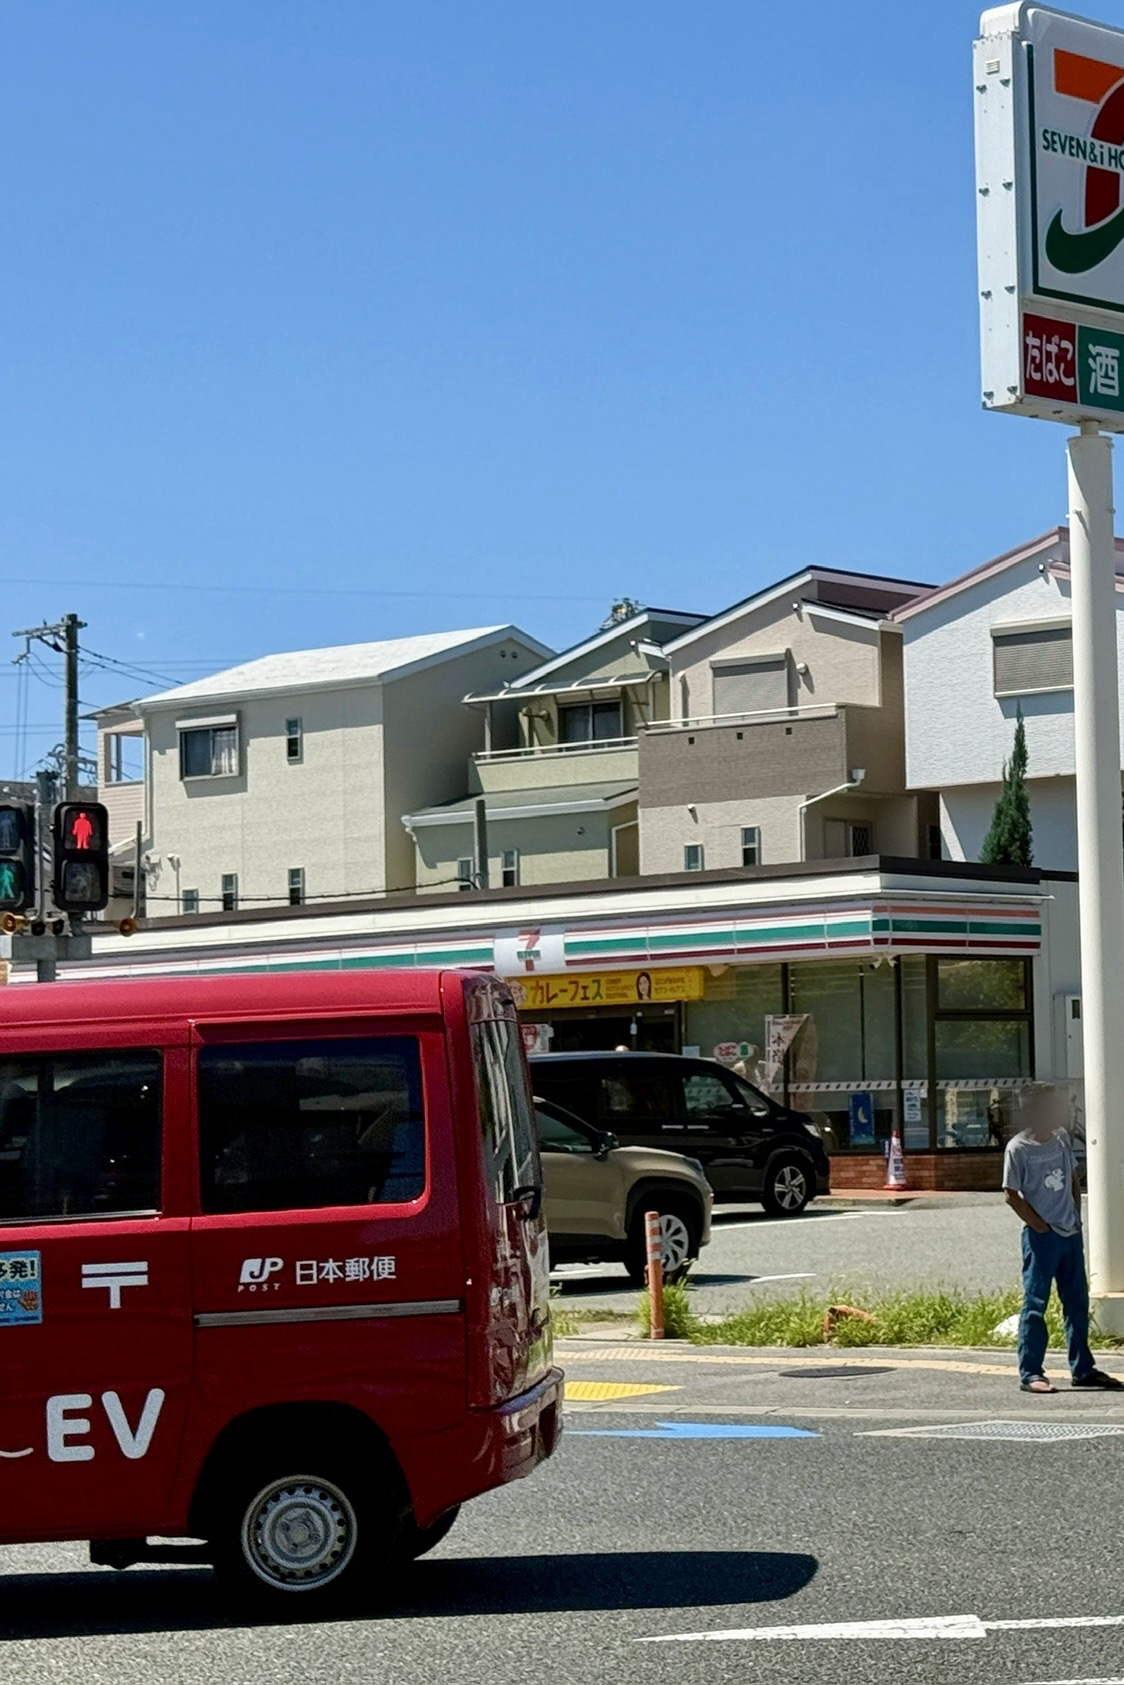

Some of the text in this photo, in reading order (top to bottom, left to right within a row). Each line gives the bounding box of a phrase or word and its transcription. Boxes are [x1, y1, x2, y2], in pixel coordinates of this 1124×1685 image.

[1025, 330, 1075, 388] たばこ
[1088, 342, 1121, 398] 酒
[530, 979, 603, 1004] カレーフェス
[240, 1257, 284, 1283] JP
[295, 1255, 397, 1286] 日本郵便
[237, 1282, 281, 1292] POST
[46, 1387, 165, 1463] EV
